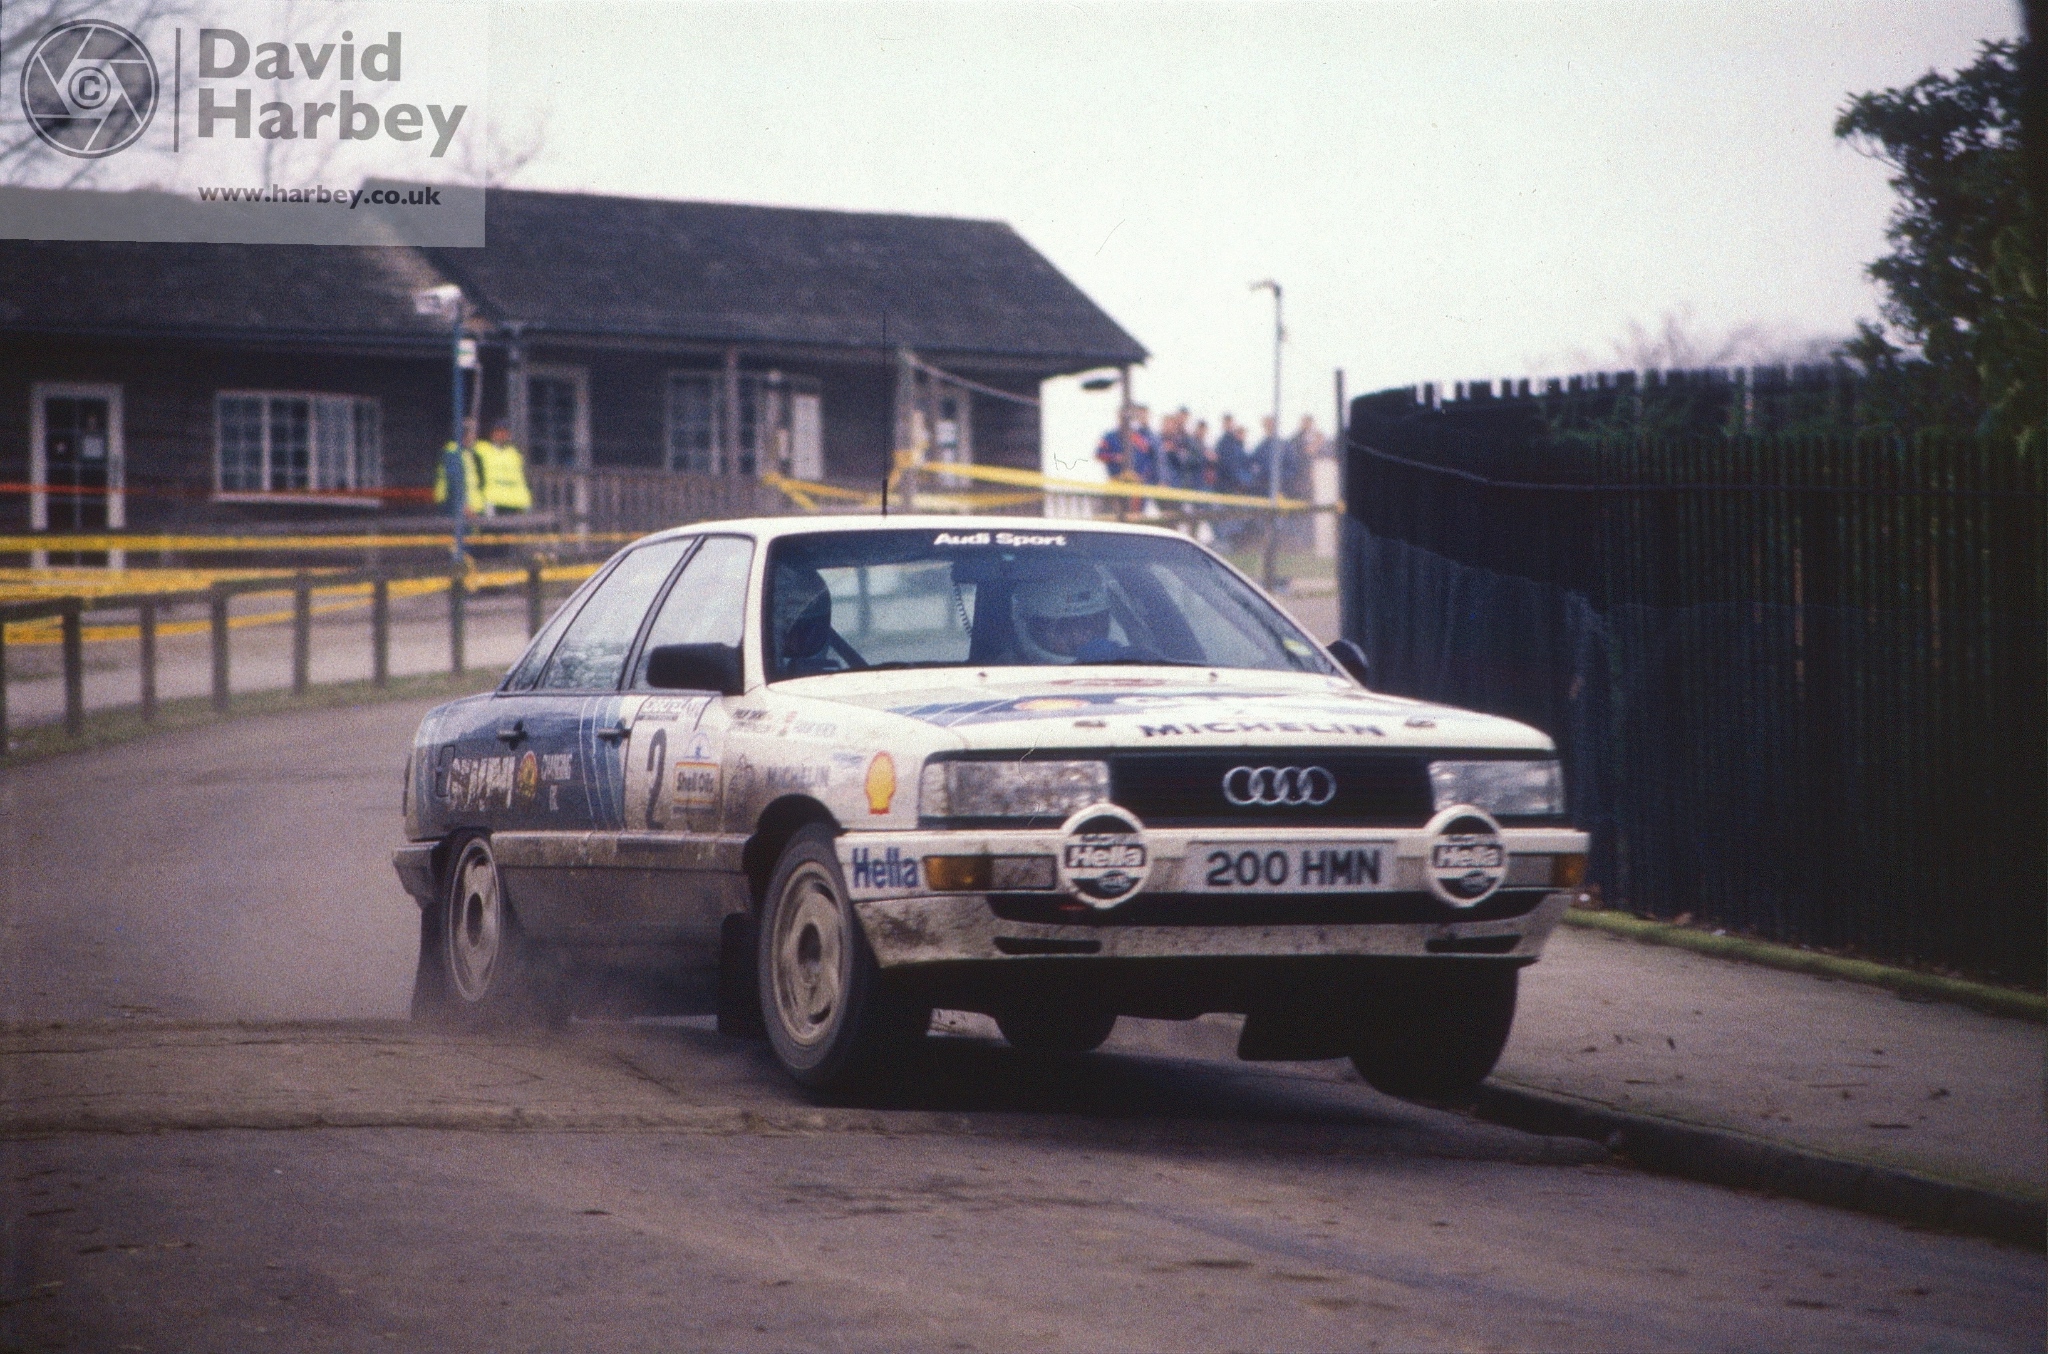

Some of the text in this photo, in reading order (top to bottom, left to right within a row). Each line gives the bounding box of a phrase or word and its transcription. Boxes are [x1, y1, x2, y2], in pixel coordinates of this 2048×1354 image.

[933, 532, 1067, 546] Audi Sport
[1137, 723, 1386, 737] MICHELIN
[645, 728, 667, 829] 2
[1069, 846, 1142, 867] Hella
[1438, 846, 1500, 867] Hella
[852, 847, 918, 888] Hella
[1207, 850, 1381, 886] 200 HMN
